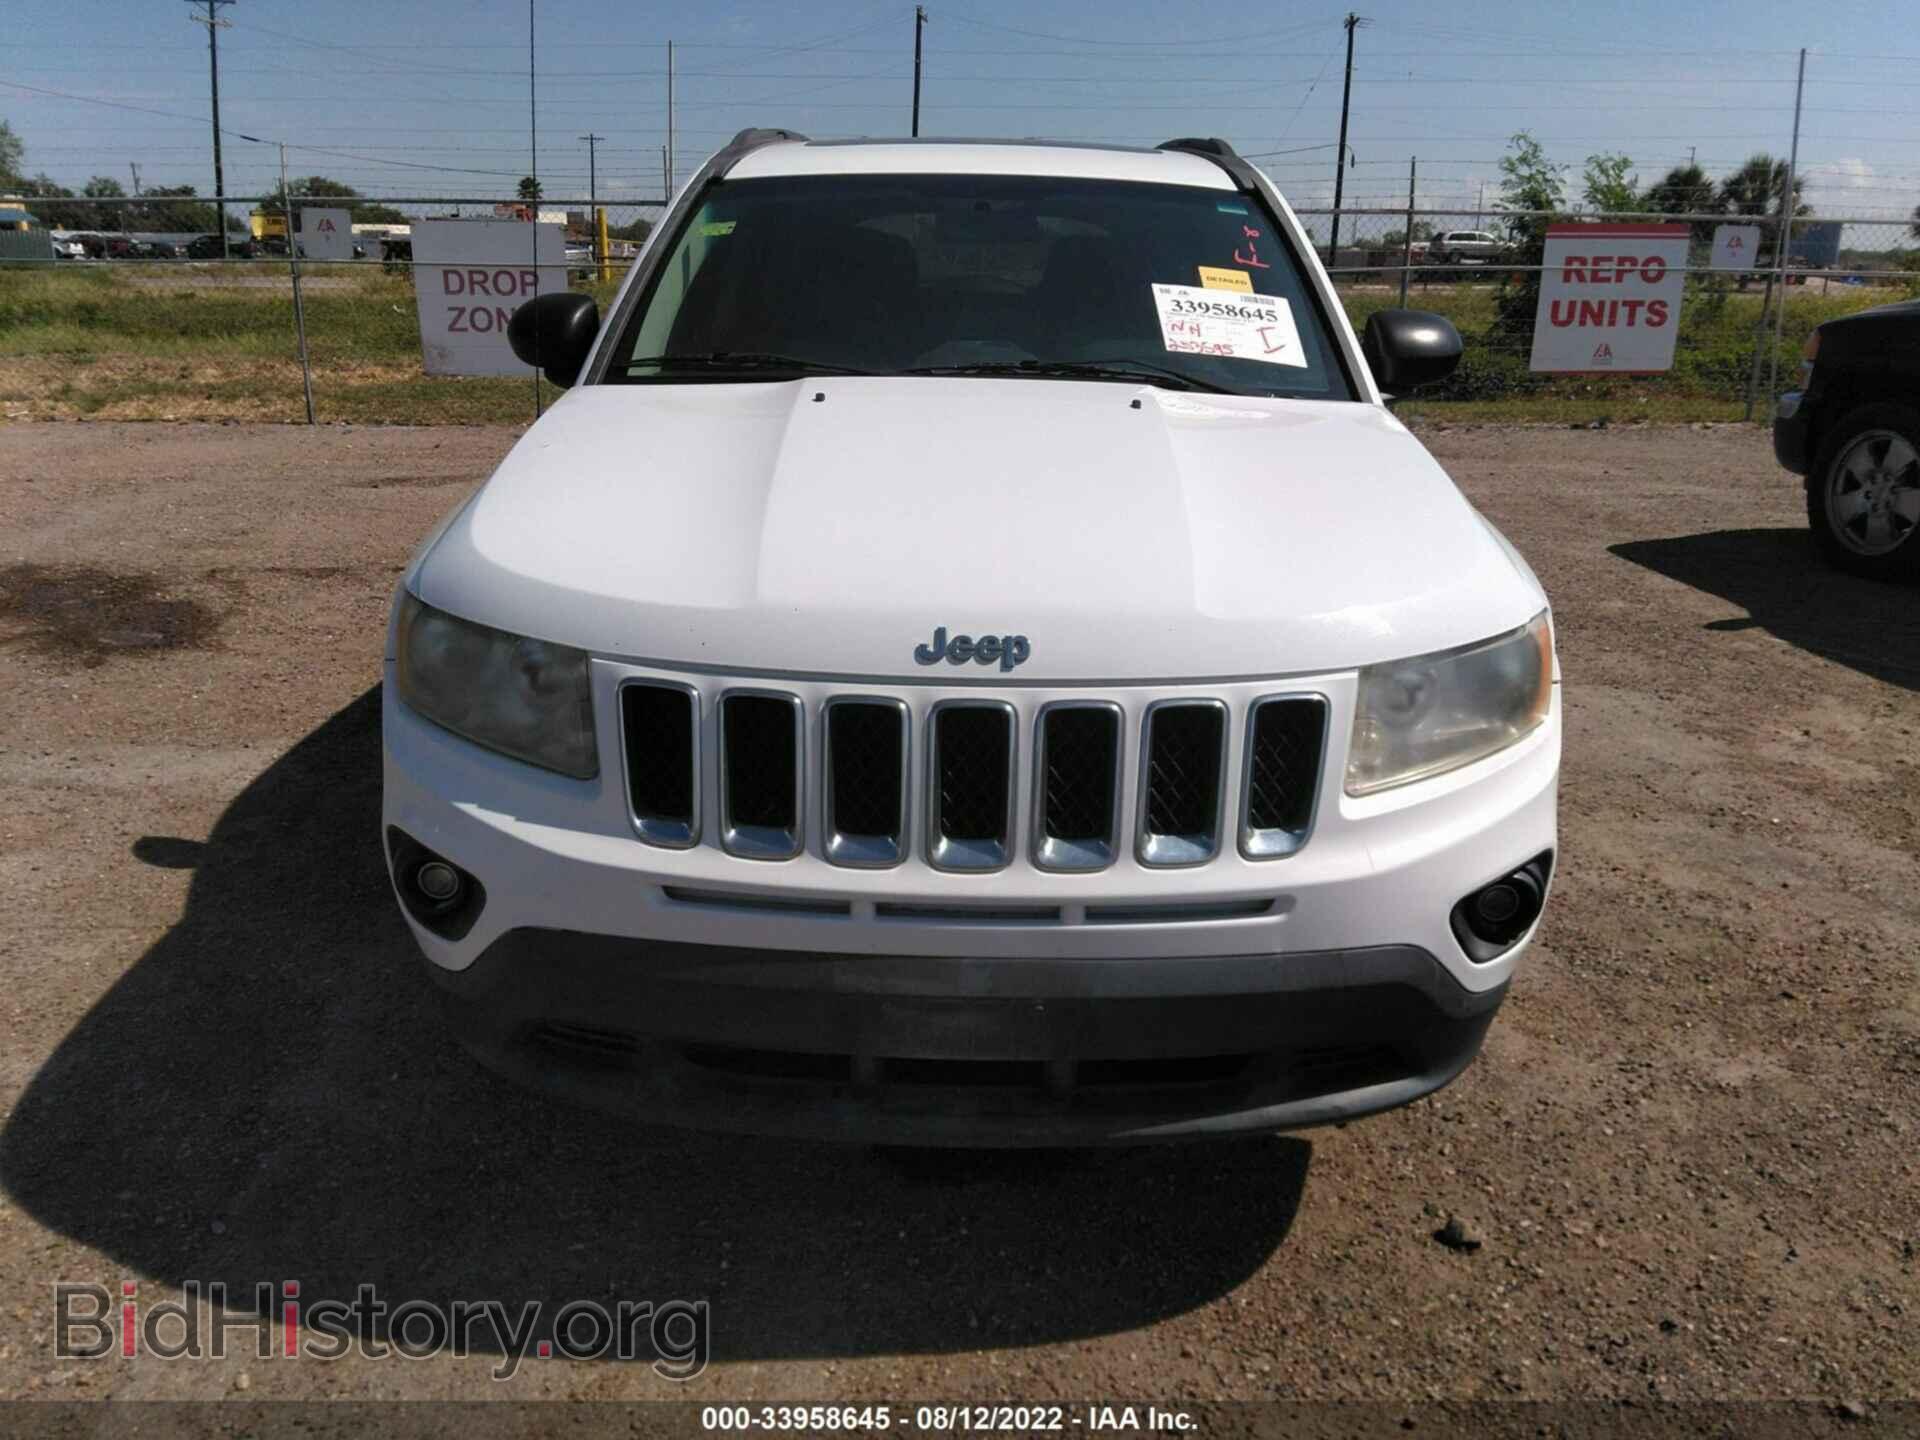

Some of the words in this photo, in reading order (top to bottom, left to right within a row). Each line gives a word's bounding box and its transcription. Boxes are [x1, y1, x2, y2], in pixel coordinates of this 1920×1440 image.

[442, 269, 540, 296] DROP
[1562, 256, 1666, 283] REPO
[447, 306, 515, 333] ZON
[1171, 299, 1279, 323] 33958645
[1549, 299, 1669, 327] UNITS
[914, 626, 1030, 673] Jeep
